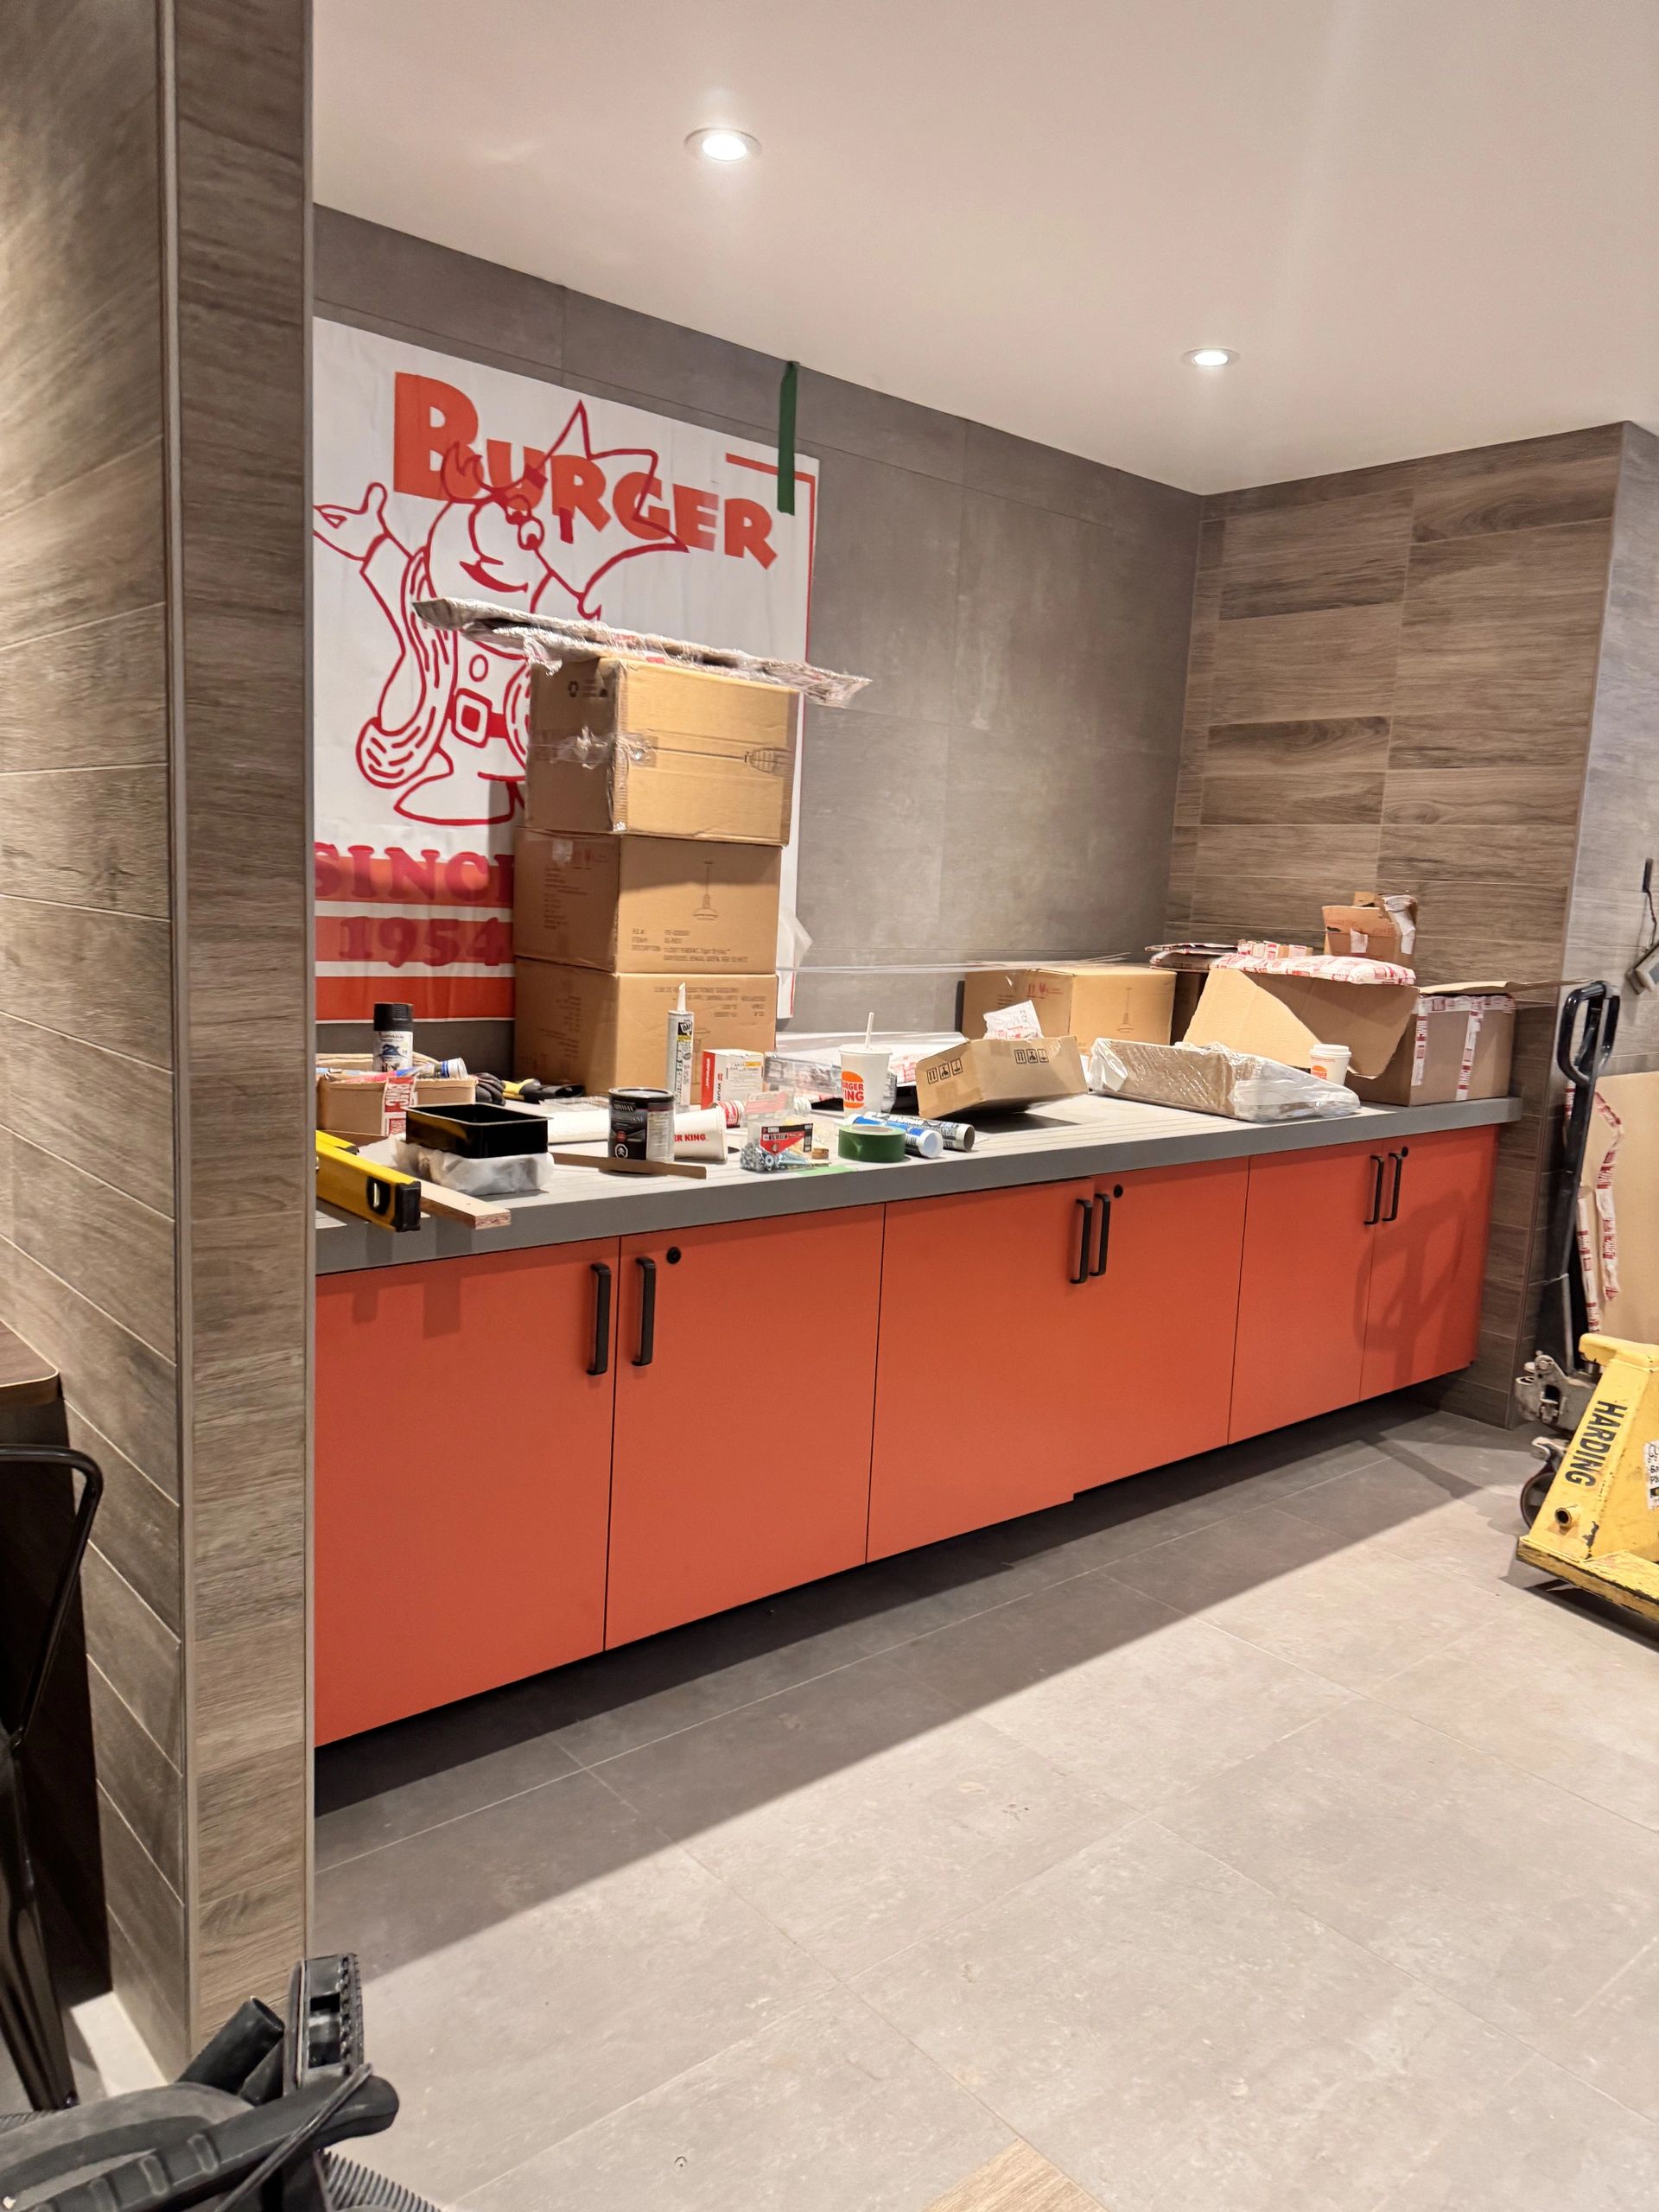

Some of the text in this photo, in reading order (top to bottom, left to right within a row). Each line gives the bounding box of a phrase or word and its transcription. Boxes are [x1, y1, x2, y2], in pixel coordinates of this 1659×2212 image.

[393, 372, 778, 569] BURGER
[339, 916, 505, 968] 1954
[843, 1090, 865, 1102] ING
[1565, 1400, 1628, 1487] HARDING
